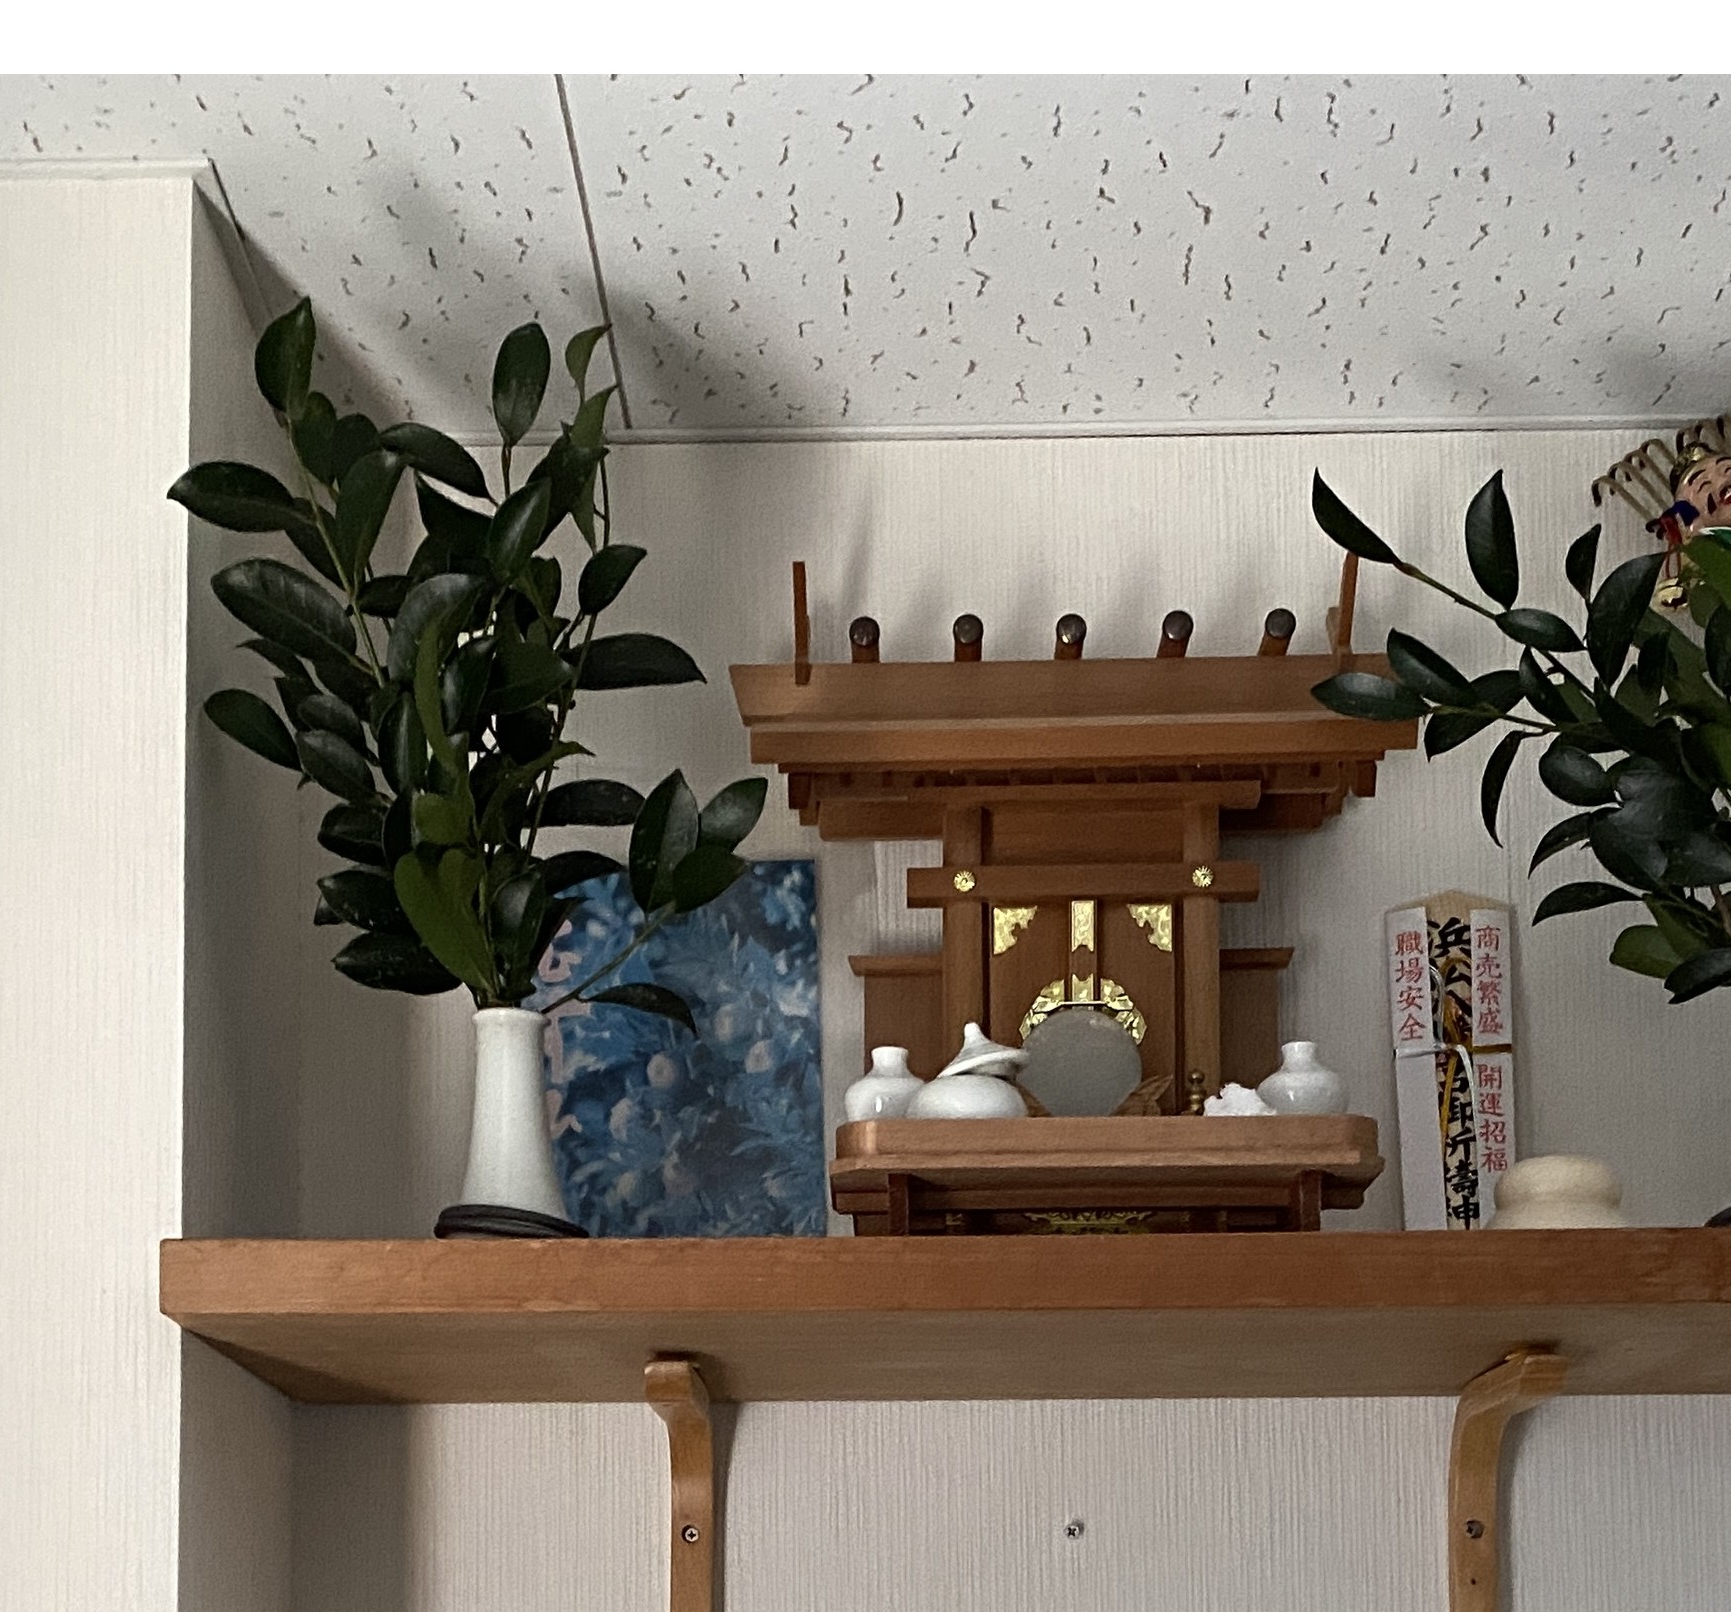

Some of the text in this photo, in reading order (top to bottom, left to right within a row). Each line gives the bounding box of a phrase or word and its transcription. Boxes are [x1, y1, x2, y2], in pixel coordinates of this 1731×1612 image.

[1394, 929, 1427, 1042] 職場安全
[1475, 924, 1509, 1173] 商売繁盛 開運招福
